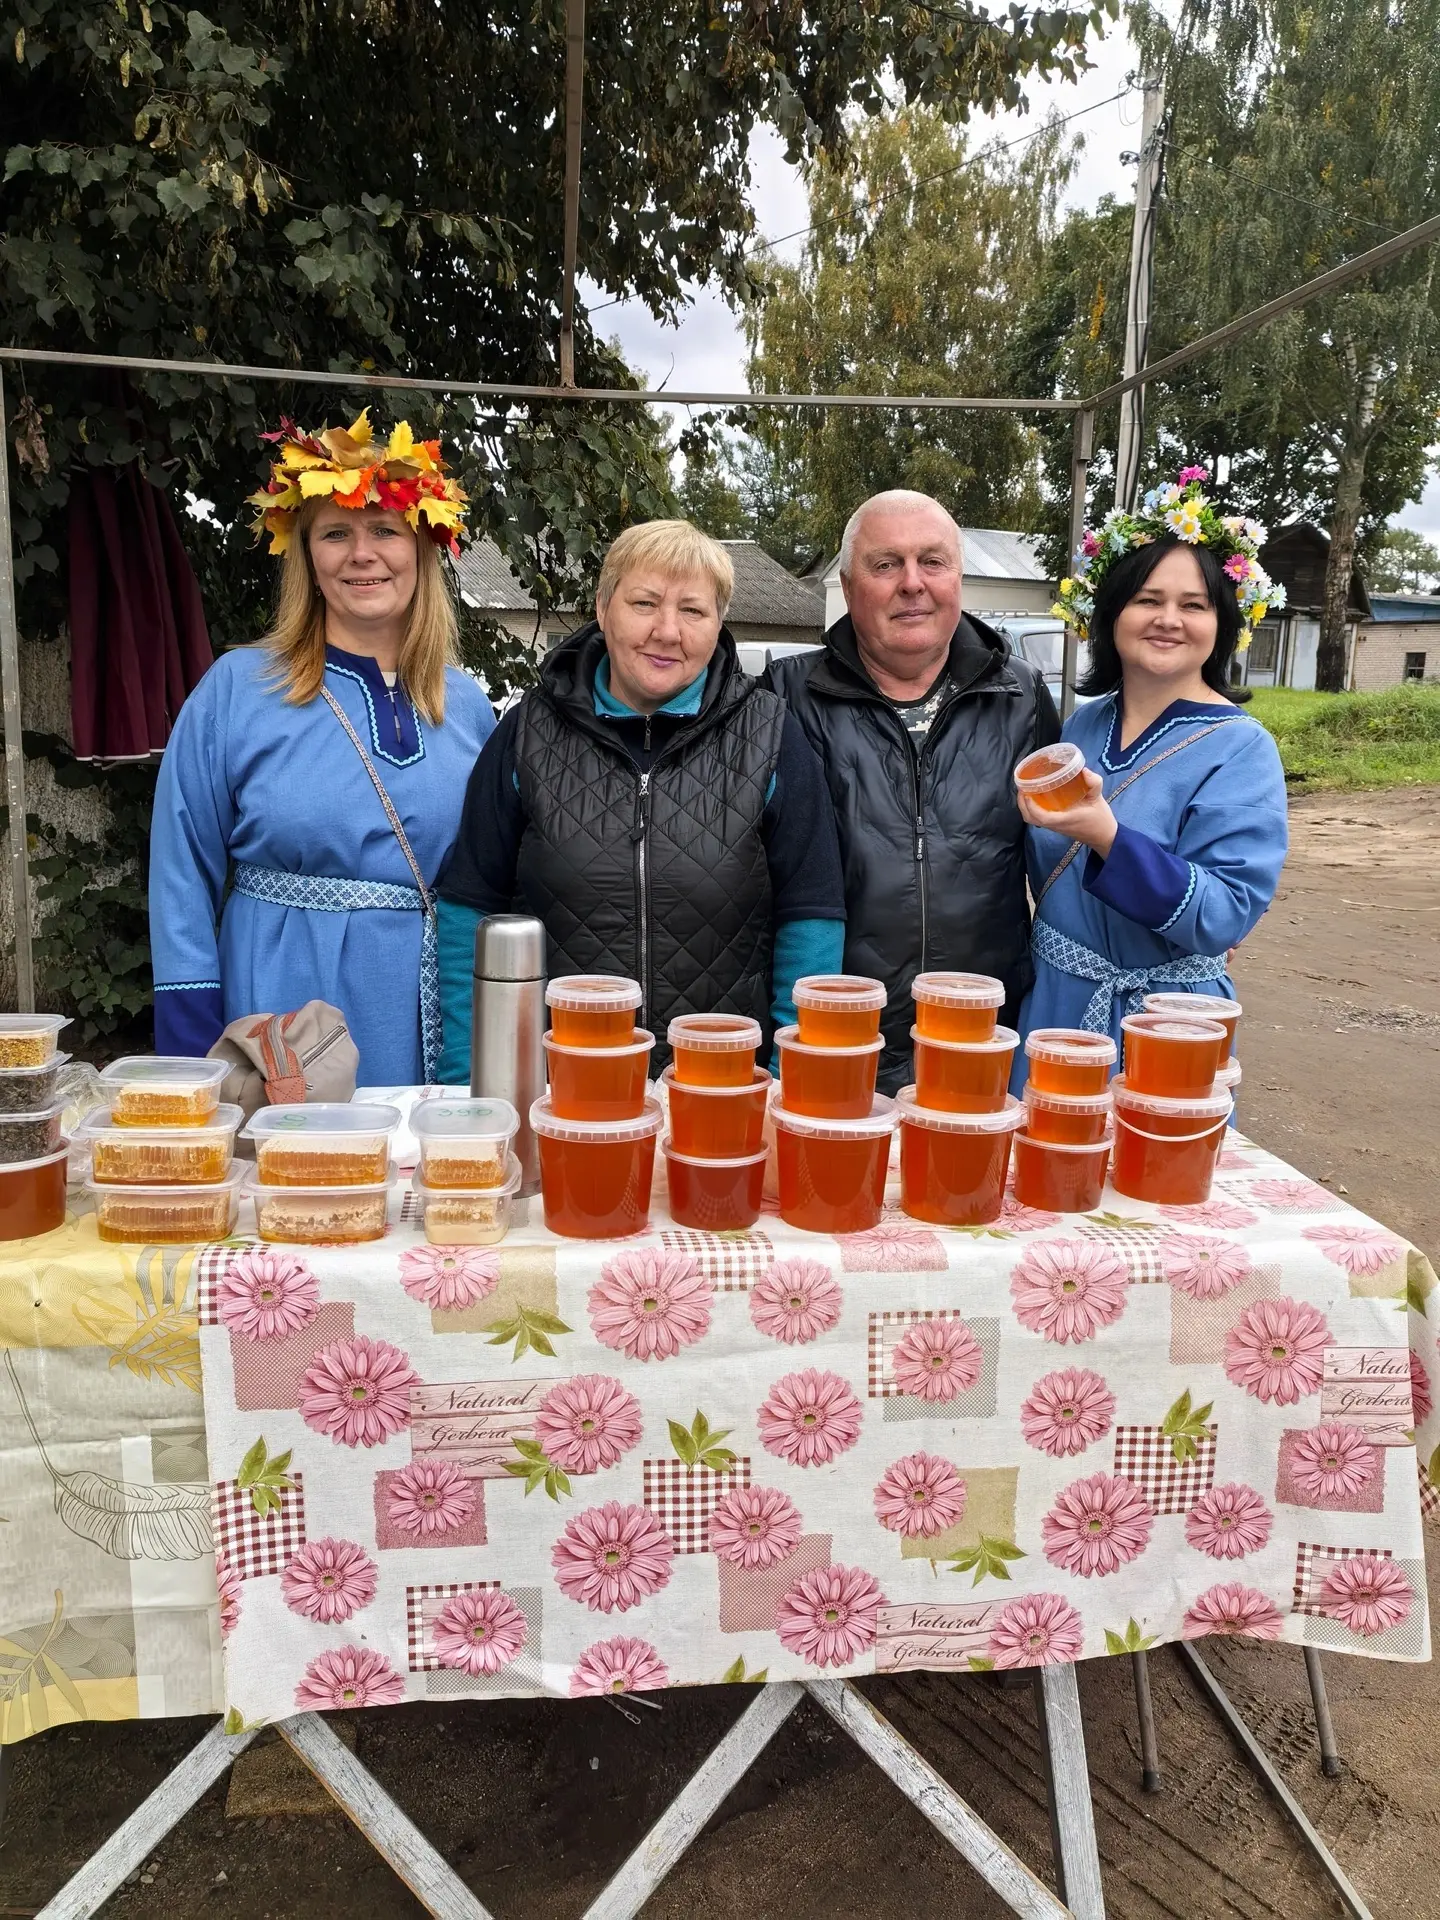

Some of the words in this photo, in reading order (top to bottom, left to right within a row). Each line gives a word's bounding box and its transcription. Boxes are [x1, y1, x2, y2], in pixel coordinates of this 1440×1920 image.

[421, 1384, 538, 1411] Natural
[424, 1417, 509, 1454] Gerbera
[886, 1606, 992, 1630] Natural
[888, 1637, 964, 1672] Gerbera
